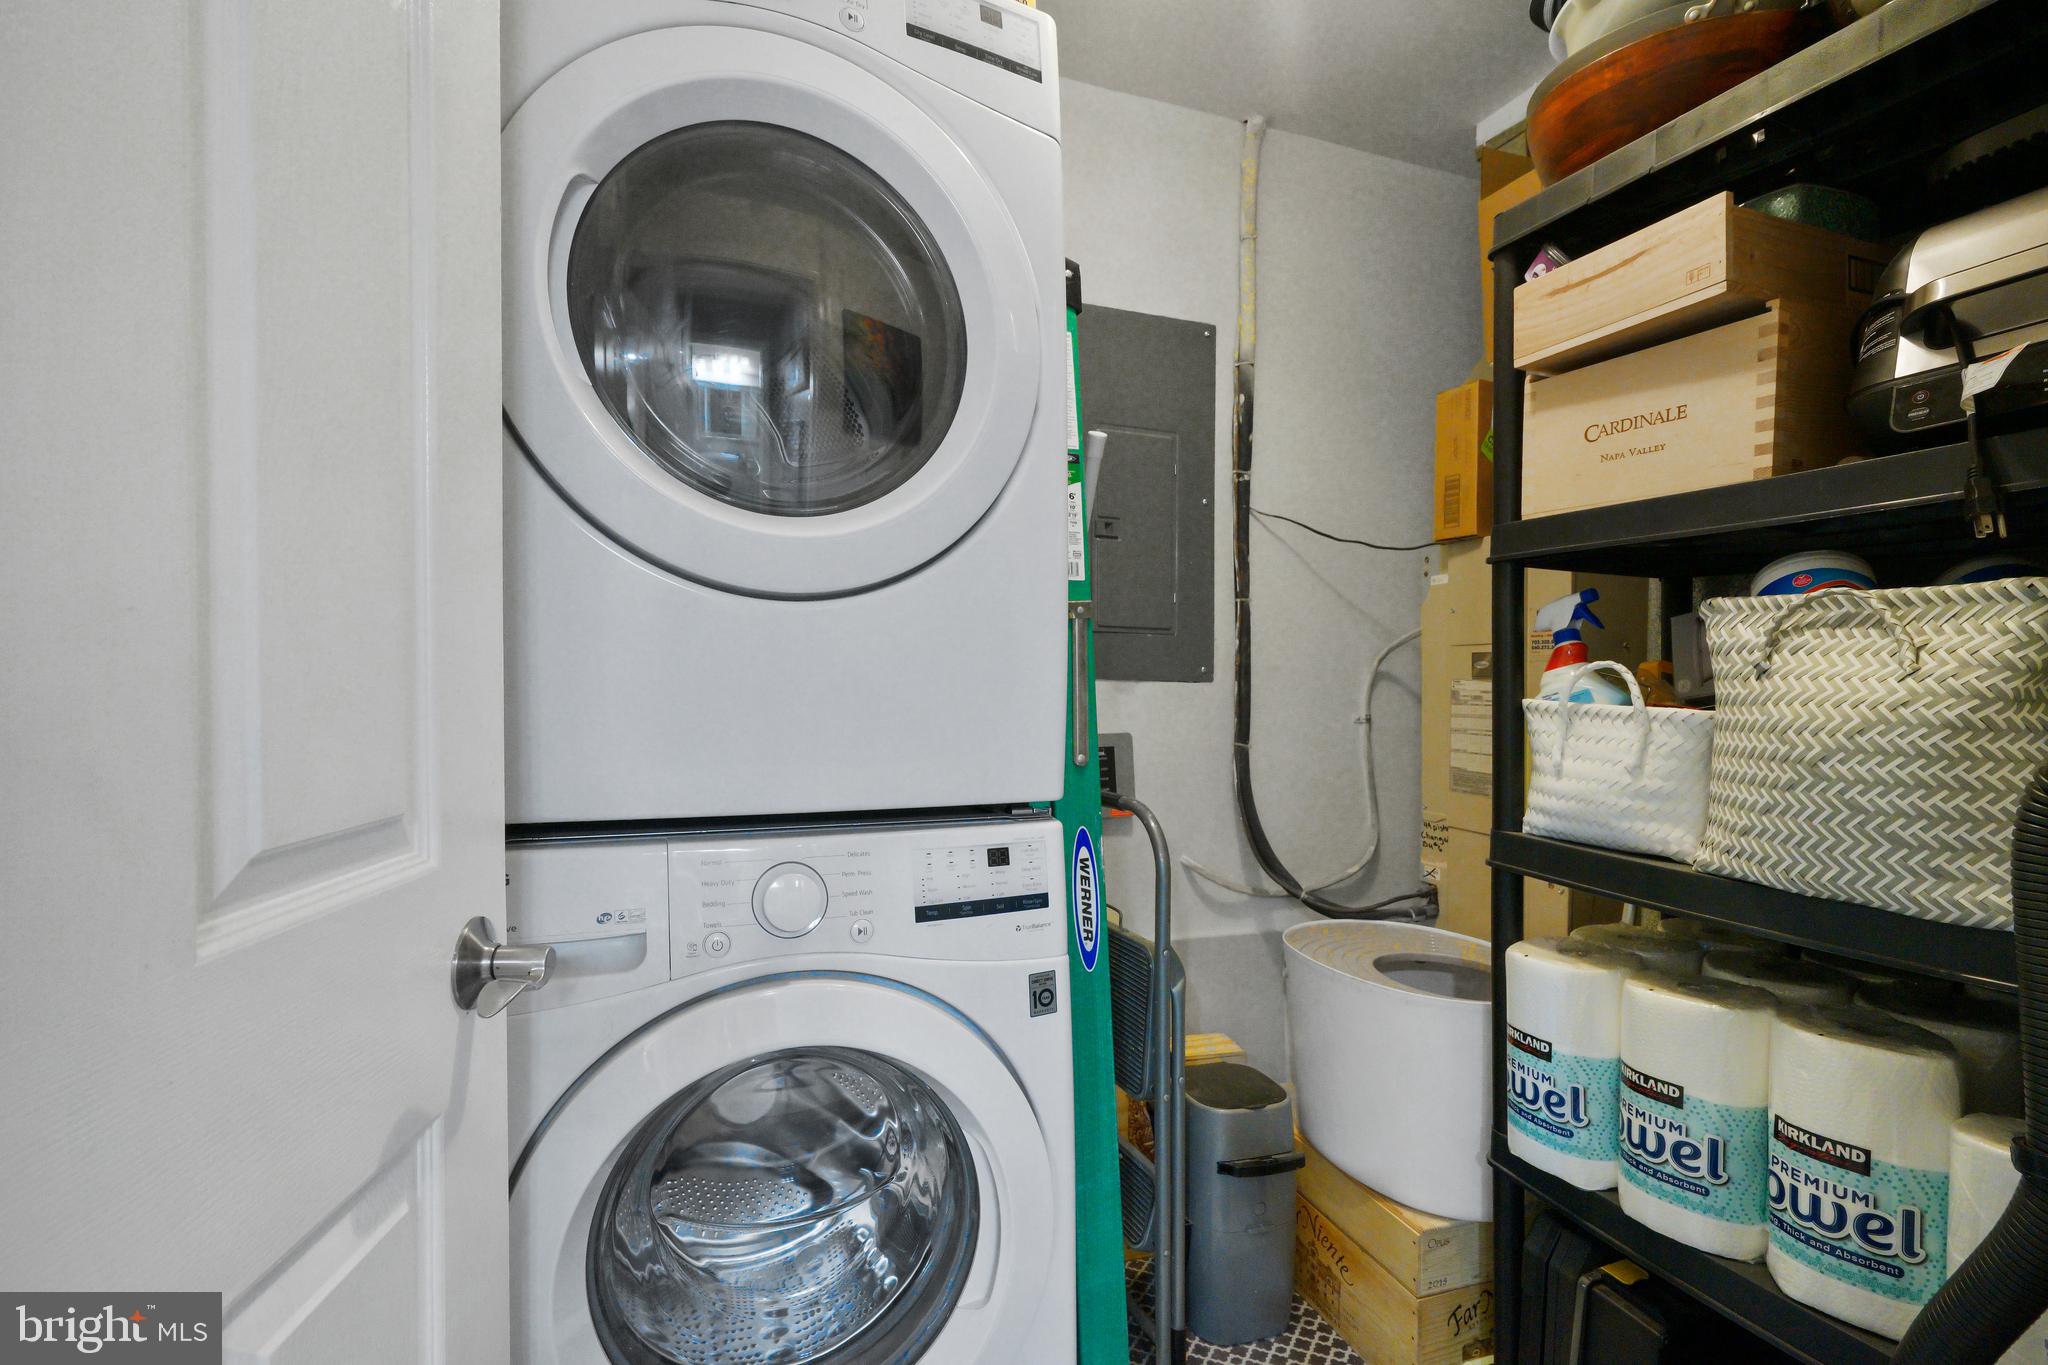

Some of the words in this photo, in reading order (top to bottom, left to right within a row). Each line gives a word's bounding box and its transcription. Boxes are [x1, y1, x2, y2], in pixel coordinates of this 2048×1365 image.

[1584, 404, 1688, 443] CARDINALE
[1600, 451, 1626, 463] NAPA
[1629, 443, 1666, 457] VALLEY
[1079, 857, 1095, 943] WERNER
[1777, 1119, 1866, 1163] KIRKLAND
[1638, 1163, 1654, 1176] and
[1656, 1172, 1707, 1195] Absorbent
[1771, 1154, 1870, 1208] PREMIUM
[1301, 1205, 1354, 1287] Niente
[1783, 1222, 1806, 1242] Thick
[1809, 1238, 1831, 1252] and
[1835, 1248, 1900, 1276] Absorbent
